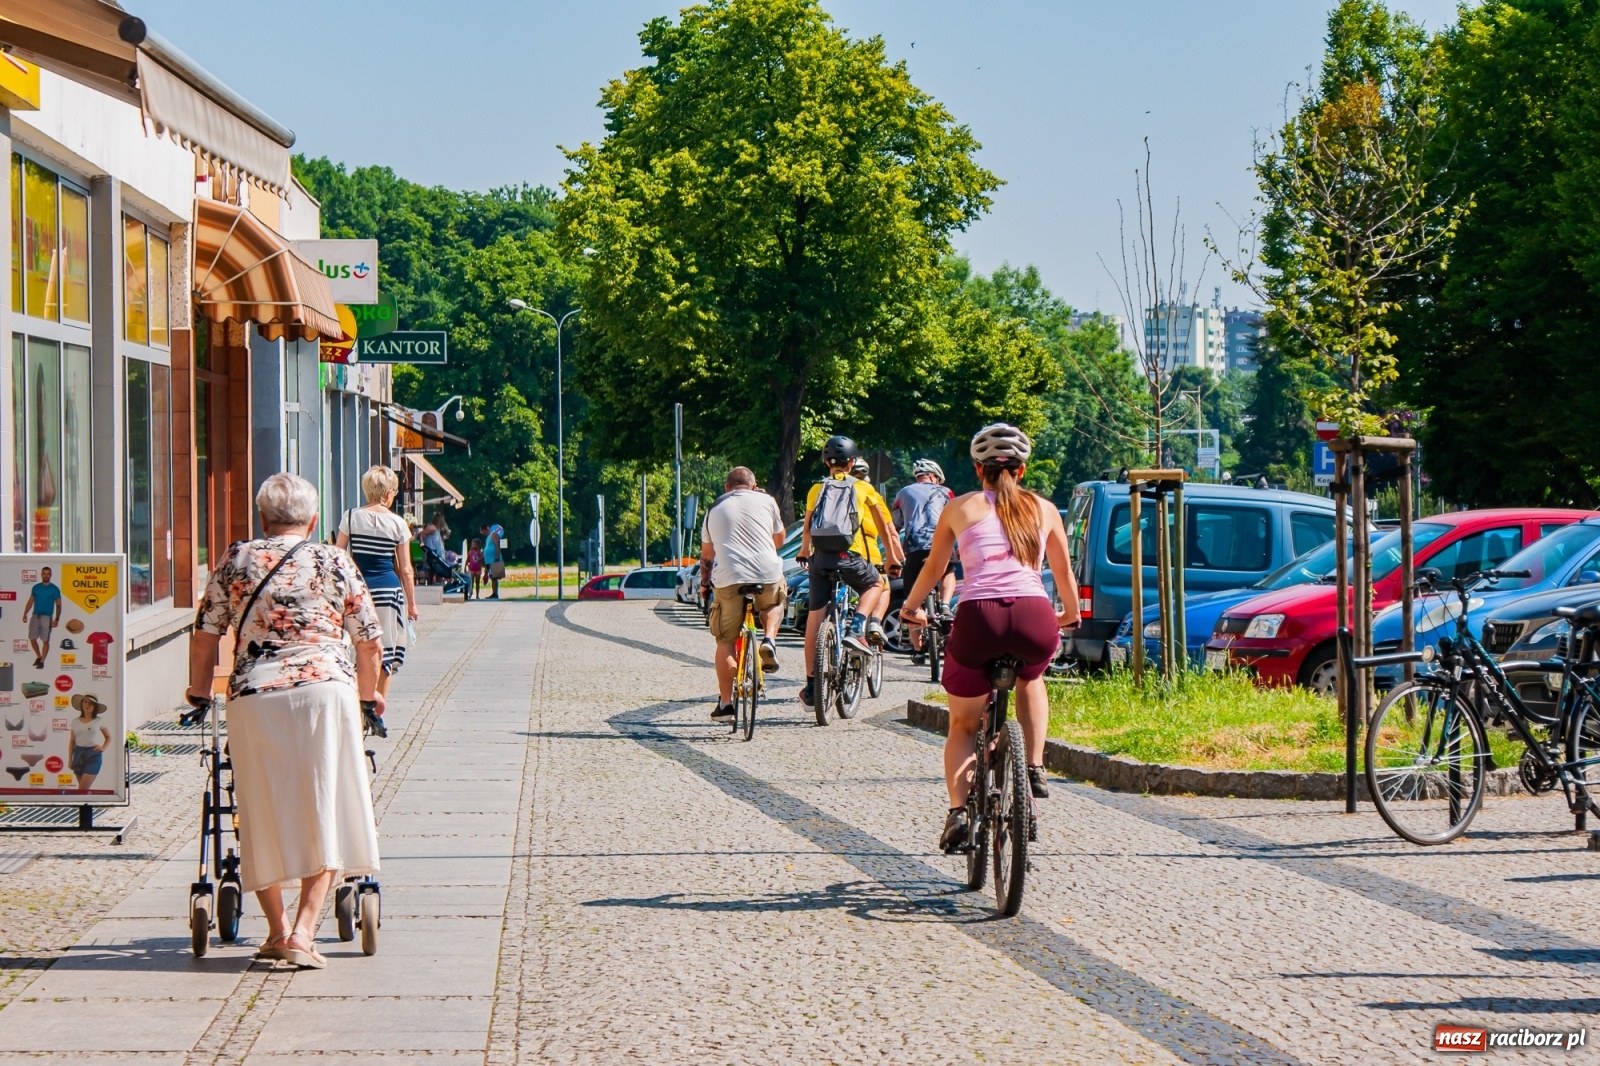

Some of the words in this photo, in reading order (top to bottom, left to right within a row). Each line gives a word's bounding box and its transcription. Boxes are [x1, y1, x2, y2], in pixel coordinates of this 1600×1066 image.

[363, 340, 441, 355] KANTOR
[76, 566, 107, 574] KUPUJ
[72, 580, 109, 588] ONLINE
